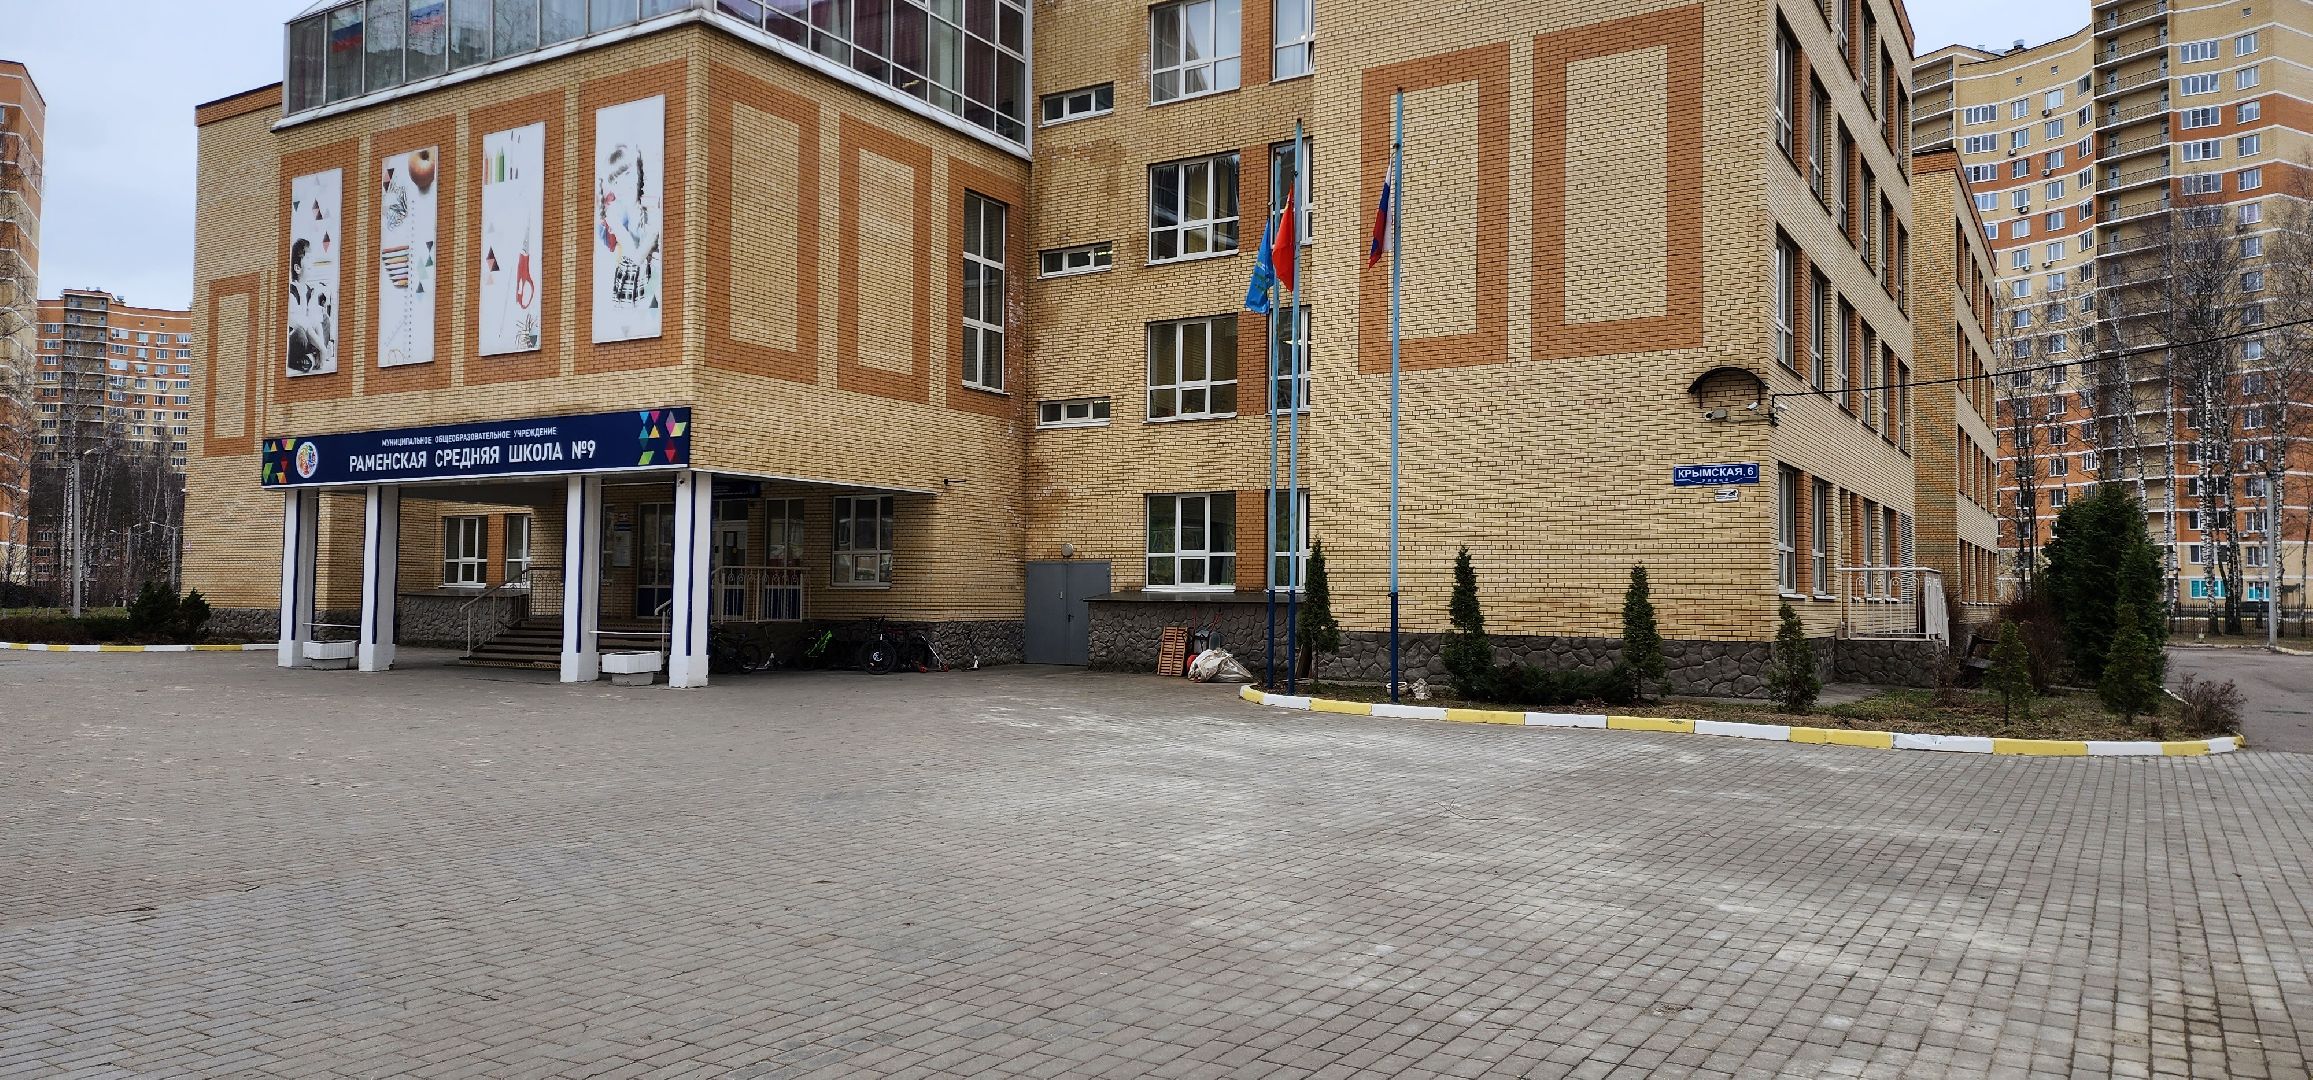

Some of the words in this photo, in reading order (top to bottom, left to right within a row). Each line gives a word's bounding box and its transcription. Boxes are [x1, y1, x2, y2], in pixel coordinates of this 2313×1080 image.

[381, 436, 432, 447] МУНИЦИПАЛЬНОЕ
[435, 430, 511, 443] ОБЩЕОБРАЗОВАТЕЛЬНОЕ
[513, 426, 557, 438] УЧРЕЖДЕНИЕ
[349, 451, 427, 472] РАМЕНСКАЯ
[435, 446, 500, 469] СРЕДНЯЯ
[508, 442, 563, 463] ШКОЛА
[571, 440, 596, 459] №9
[1747, 466, 1754, 475] 6
